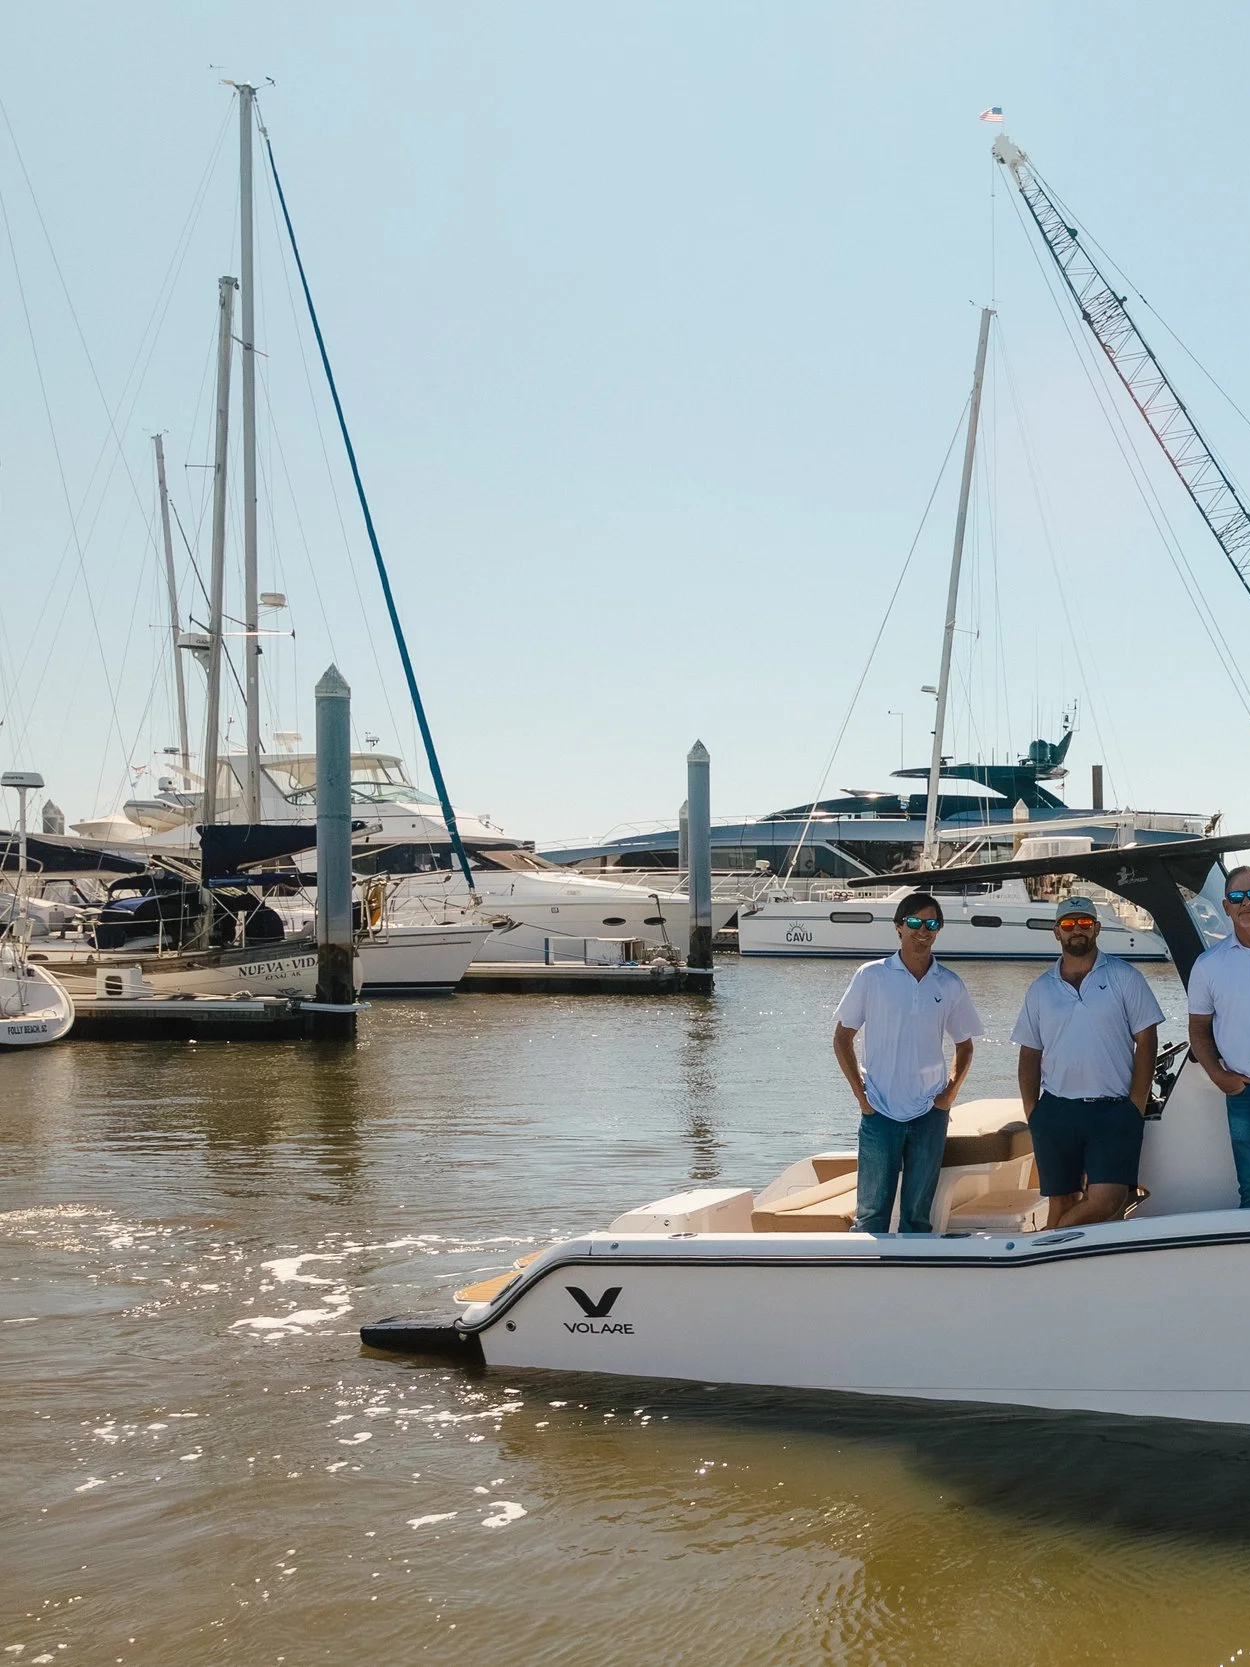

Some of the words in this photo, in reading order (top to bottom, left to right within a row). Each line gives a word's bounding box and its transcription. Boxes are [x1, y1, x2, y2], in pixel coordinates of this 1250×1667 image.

[786, 932, 813, 942] CAVU
[238, 961, 284, 977] NUEVA
[291, 957, 319, 969] VID
[563, 1322, 635, 1335] VOLARE
